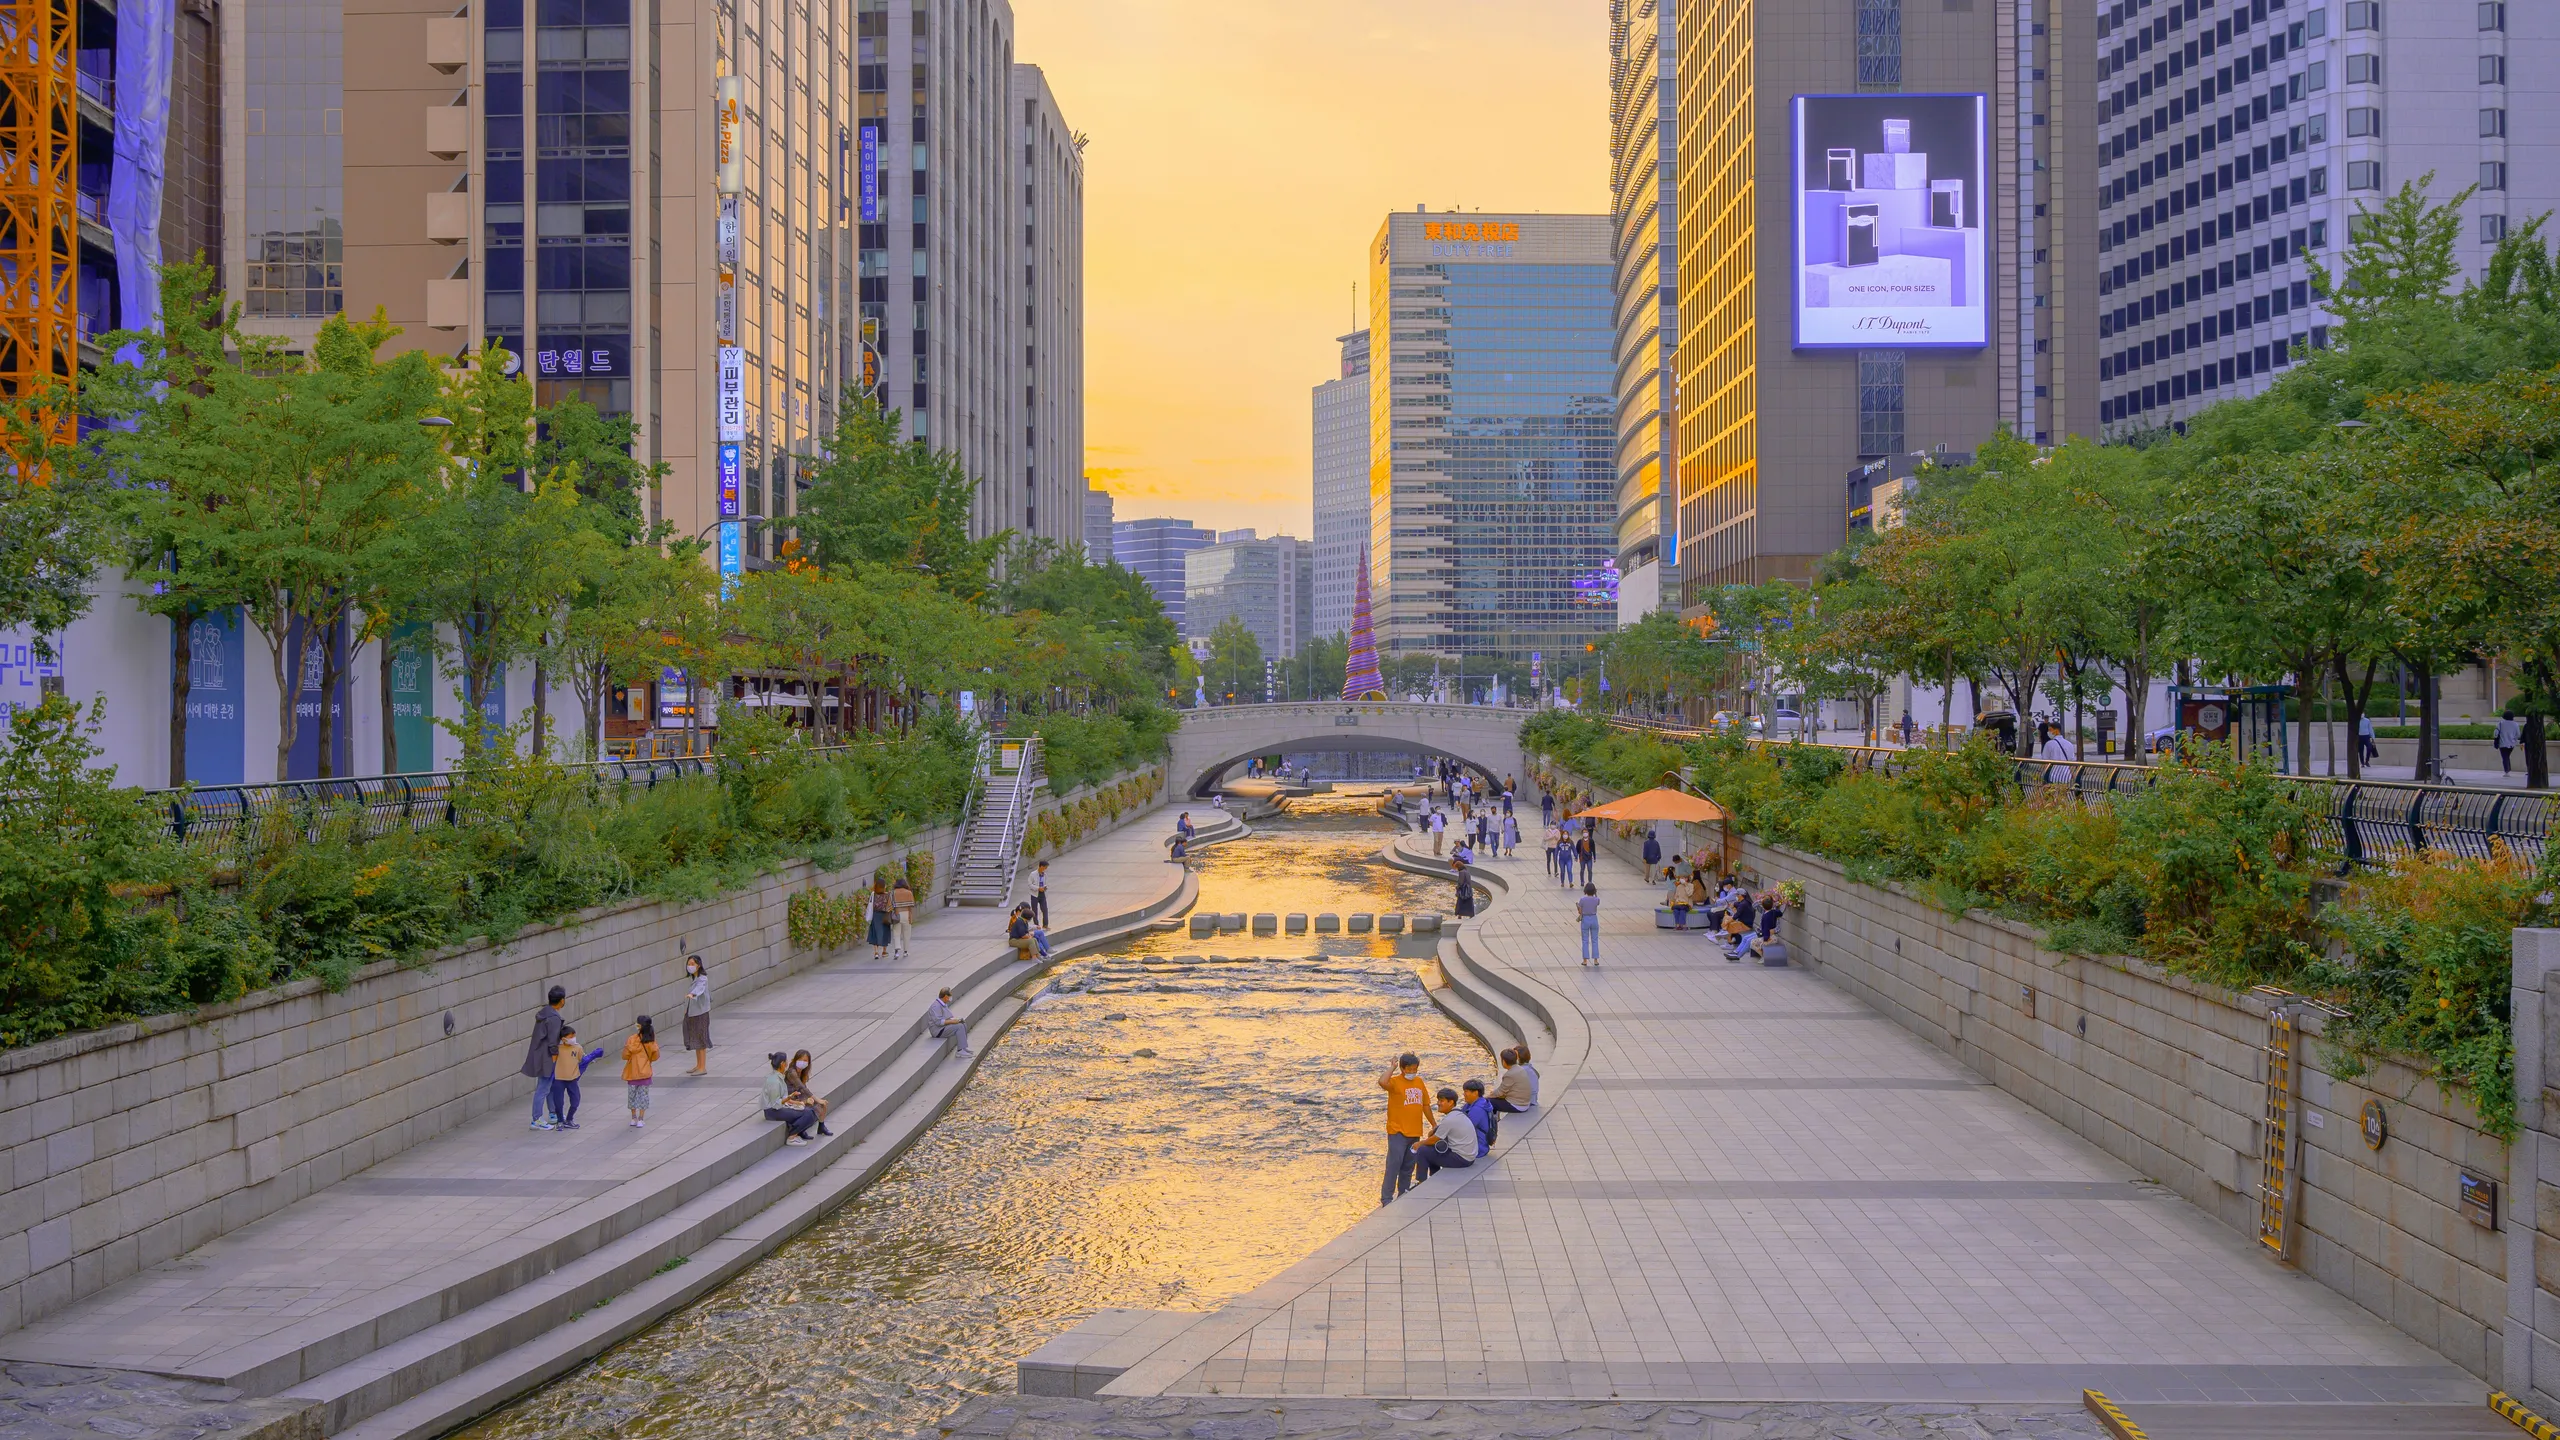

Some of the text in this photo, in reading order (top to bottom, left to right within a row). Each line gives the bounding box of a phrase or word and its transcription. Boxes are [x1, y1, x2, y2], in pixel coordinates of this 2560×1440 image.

[865, 130, 874, 205] 미래이비인후과
[1433, 244, 1513, 257] DUTY FREE
[538, 350, 612, 373] 단월드
[863, 351, 875, 387] BAR
[724, 366, 739, 424] 피부관리
[204, 703, 218, 719] 대한
[220, 703, 234, 719] 존경
